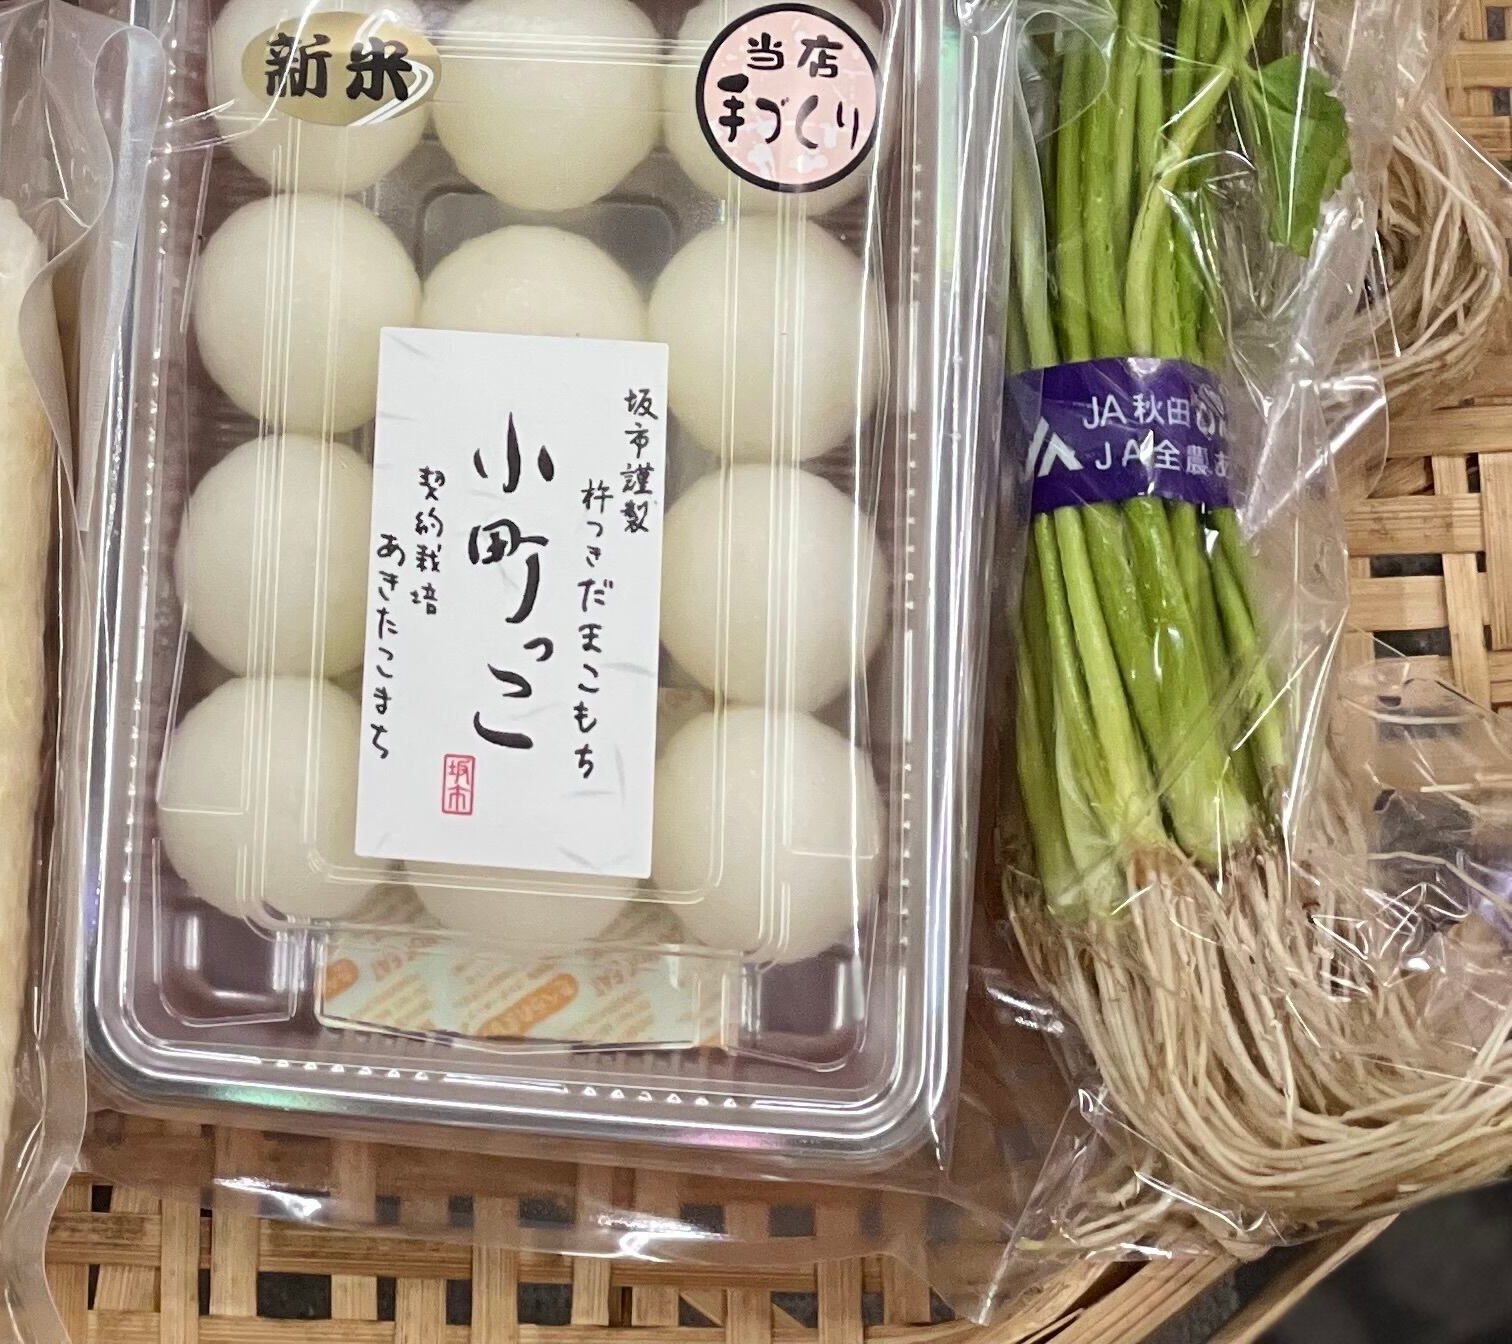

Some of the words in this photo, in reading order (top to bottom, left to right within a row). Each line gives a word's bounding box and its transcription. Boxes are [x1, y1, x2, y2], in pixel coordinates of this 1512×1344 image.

[263, 31, 413, 102] 新米
[717, 73, 861, 151] 手づくり
[746, 31, 844, 80] 当店
[619, 387, 660, 535] 坂市謹製
[409, 465, 447, 616] 契約栽培
[466, 411, 556, 752] 小町っこ
[369, 532, 407, 760] あきたこまち
[572, 478, 615, 780] 杵つきだまこもち
